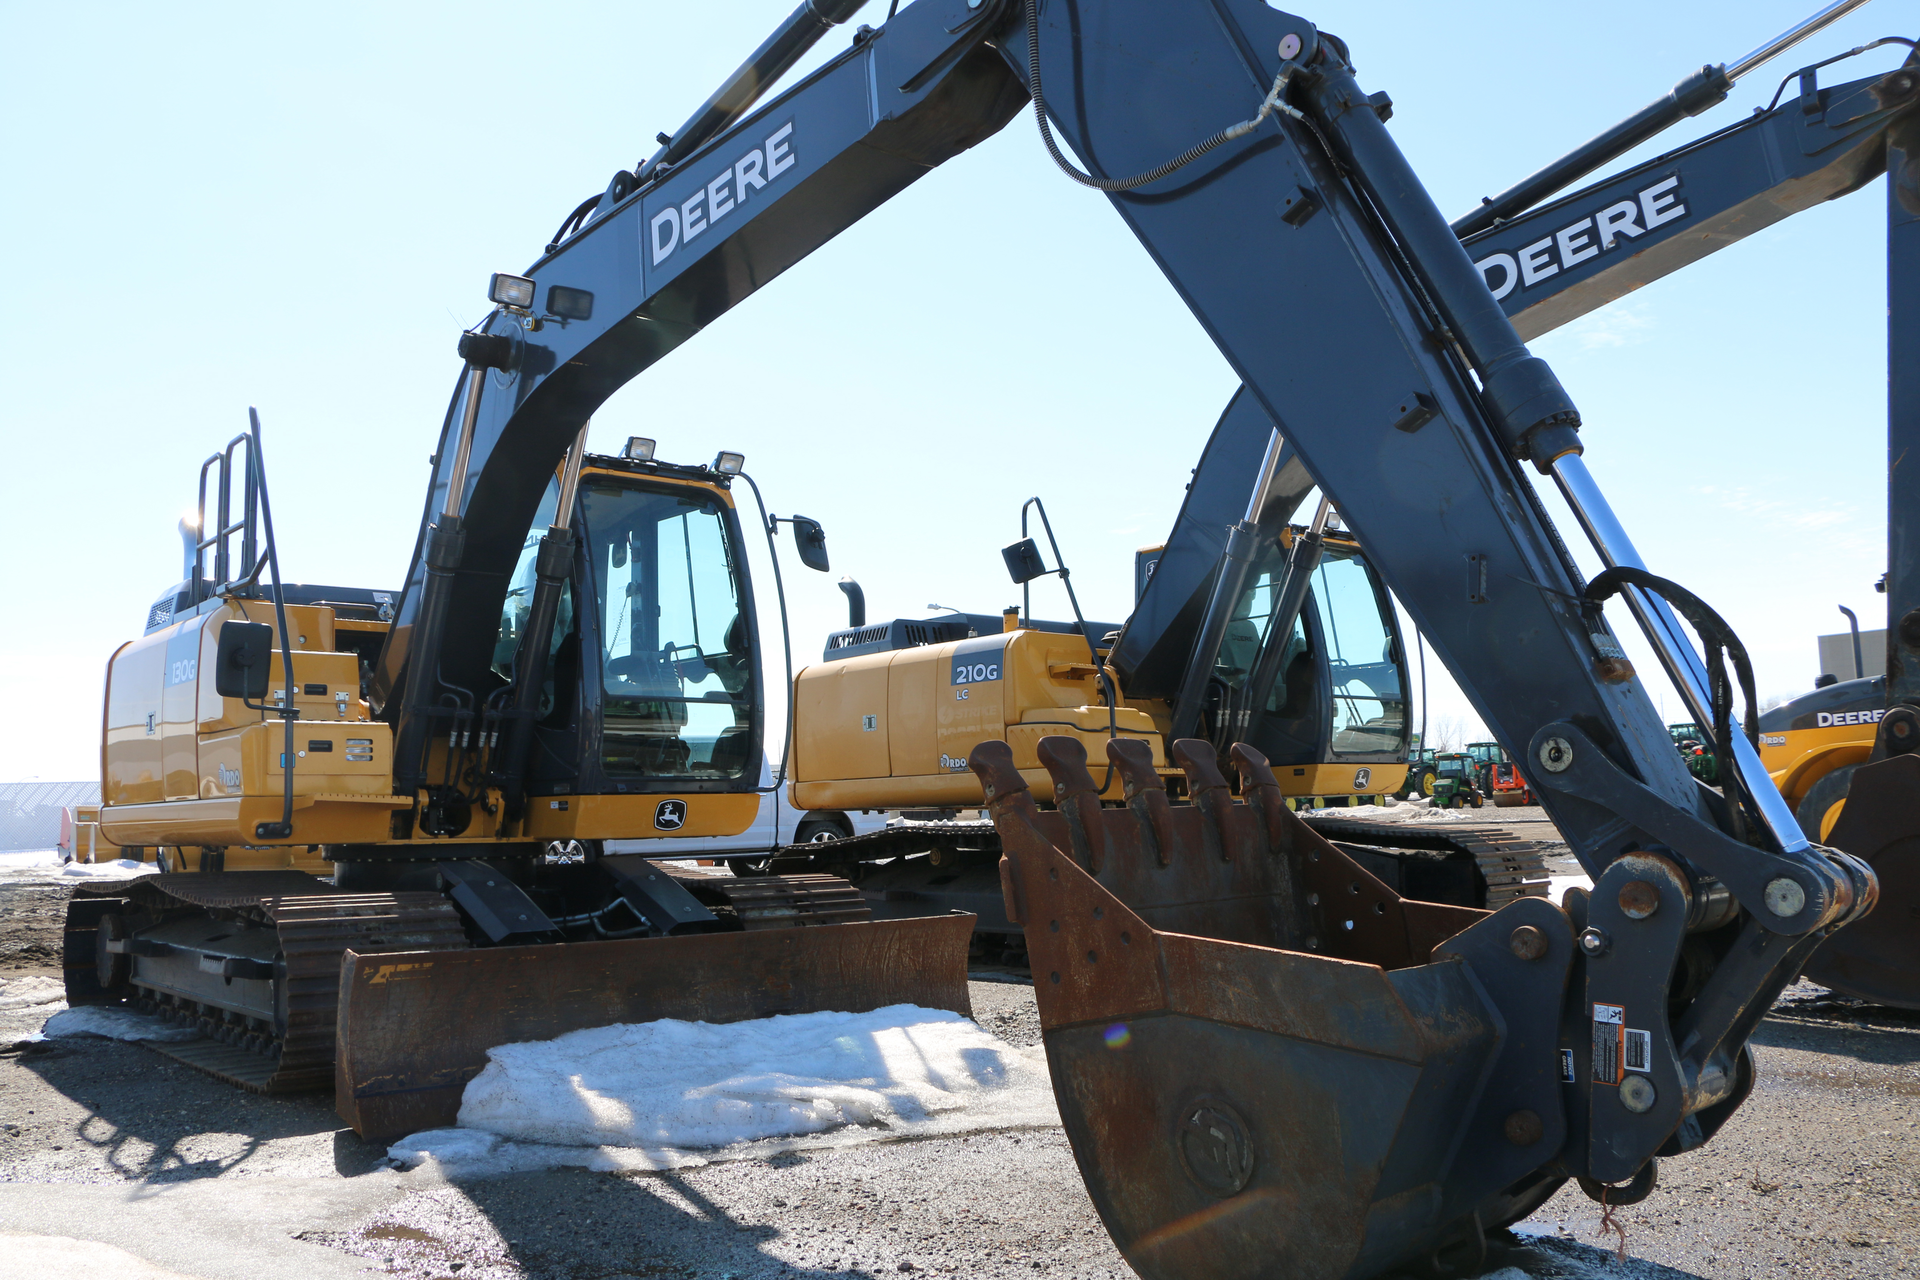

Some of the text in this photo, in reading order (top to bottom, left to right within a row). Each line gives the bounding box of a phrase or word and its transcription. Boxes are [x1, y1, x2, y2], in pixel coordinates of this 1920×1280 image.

[651, 121, 796, 266] DEERE
[1474, 175, 1687, 301] DEERE
[172, 659, 195, 684] 130G
[956, 663, 998, 684] 210G
[956, 689, 969, 700] LC
[956, 706, 997, 719] STRIKE
[1817, 709, 1886, 727] DEERE
[1767, 735, 1786, 743] RDO
[949, 758, 967, 768] RDO
